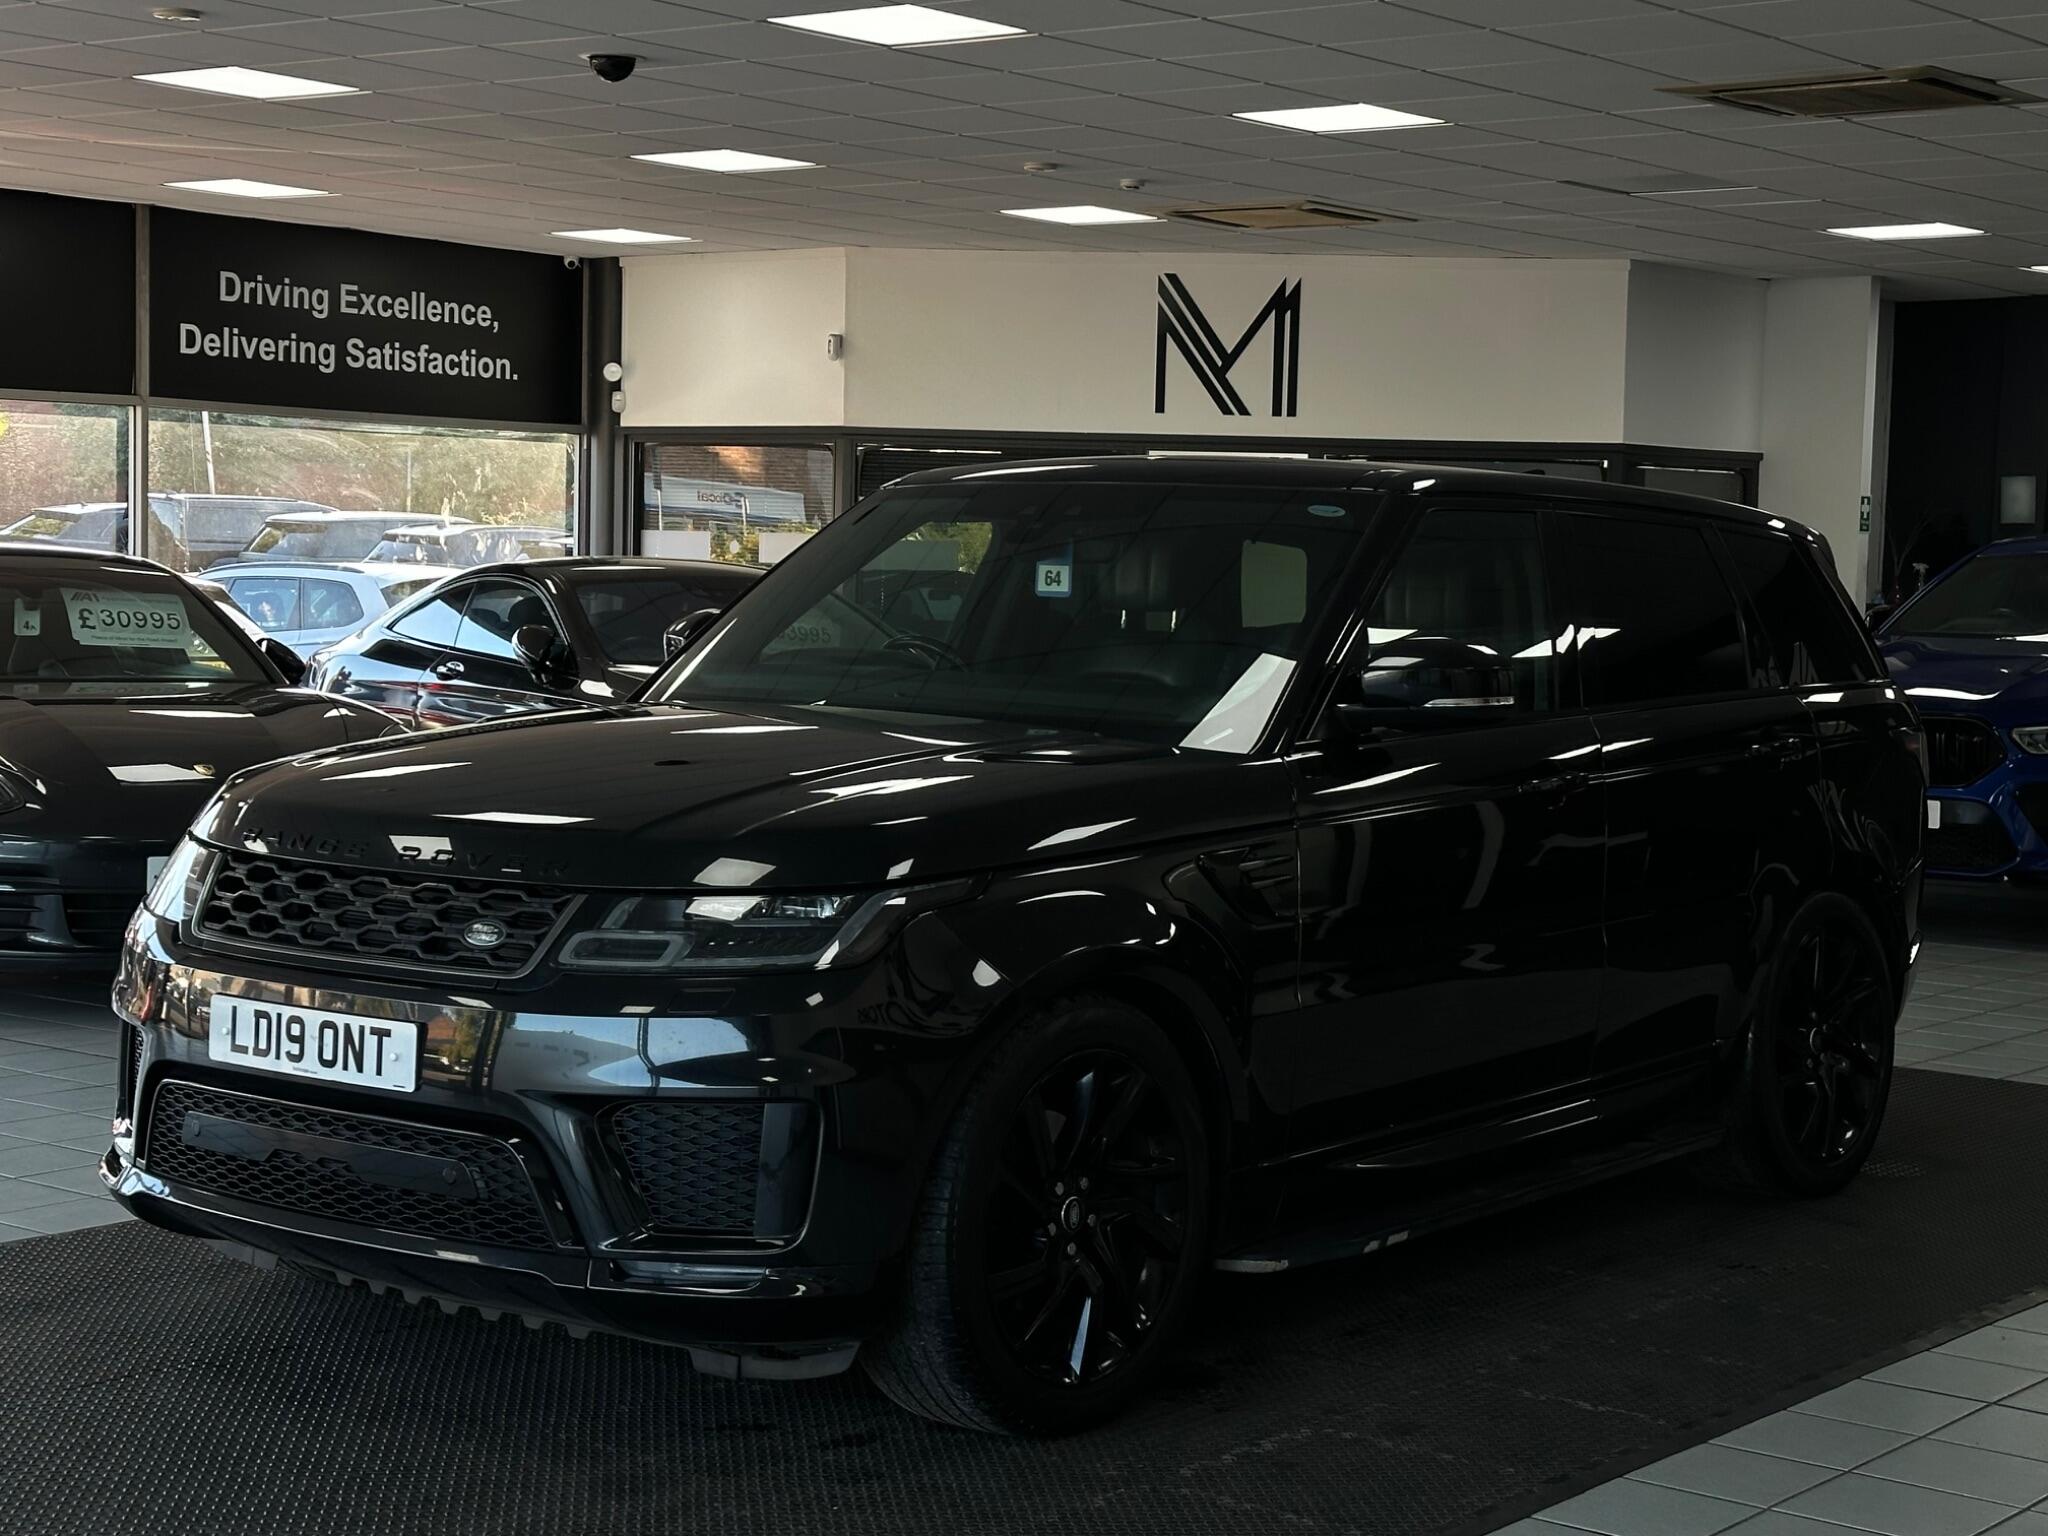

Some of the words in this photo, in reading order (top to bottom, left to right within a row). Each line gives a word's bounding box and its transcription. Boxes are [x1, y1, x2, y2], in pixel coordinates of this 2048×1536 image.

[219, 271, 329, 318] Driving
[339, 283, 499, 332] Excellence,
[179, 323, 335, 374] Delivering
[346, 338, 518, 380] Satisfaction.
[1045, 570, 1062, 587] 64
[78, 607, 181, 630] £30995
[230, 1005, 306, 1063] LD19
[318, 1019, 391, 1077] ONT
